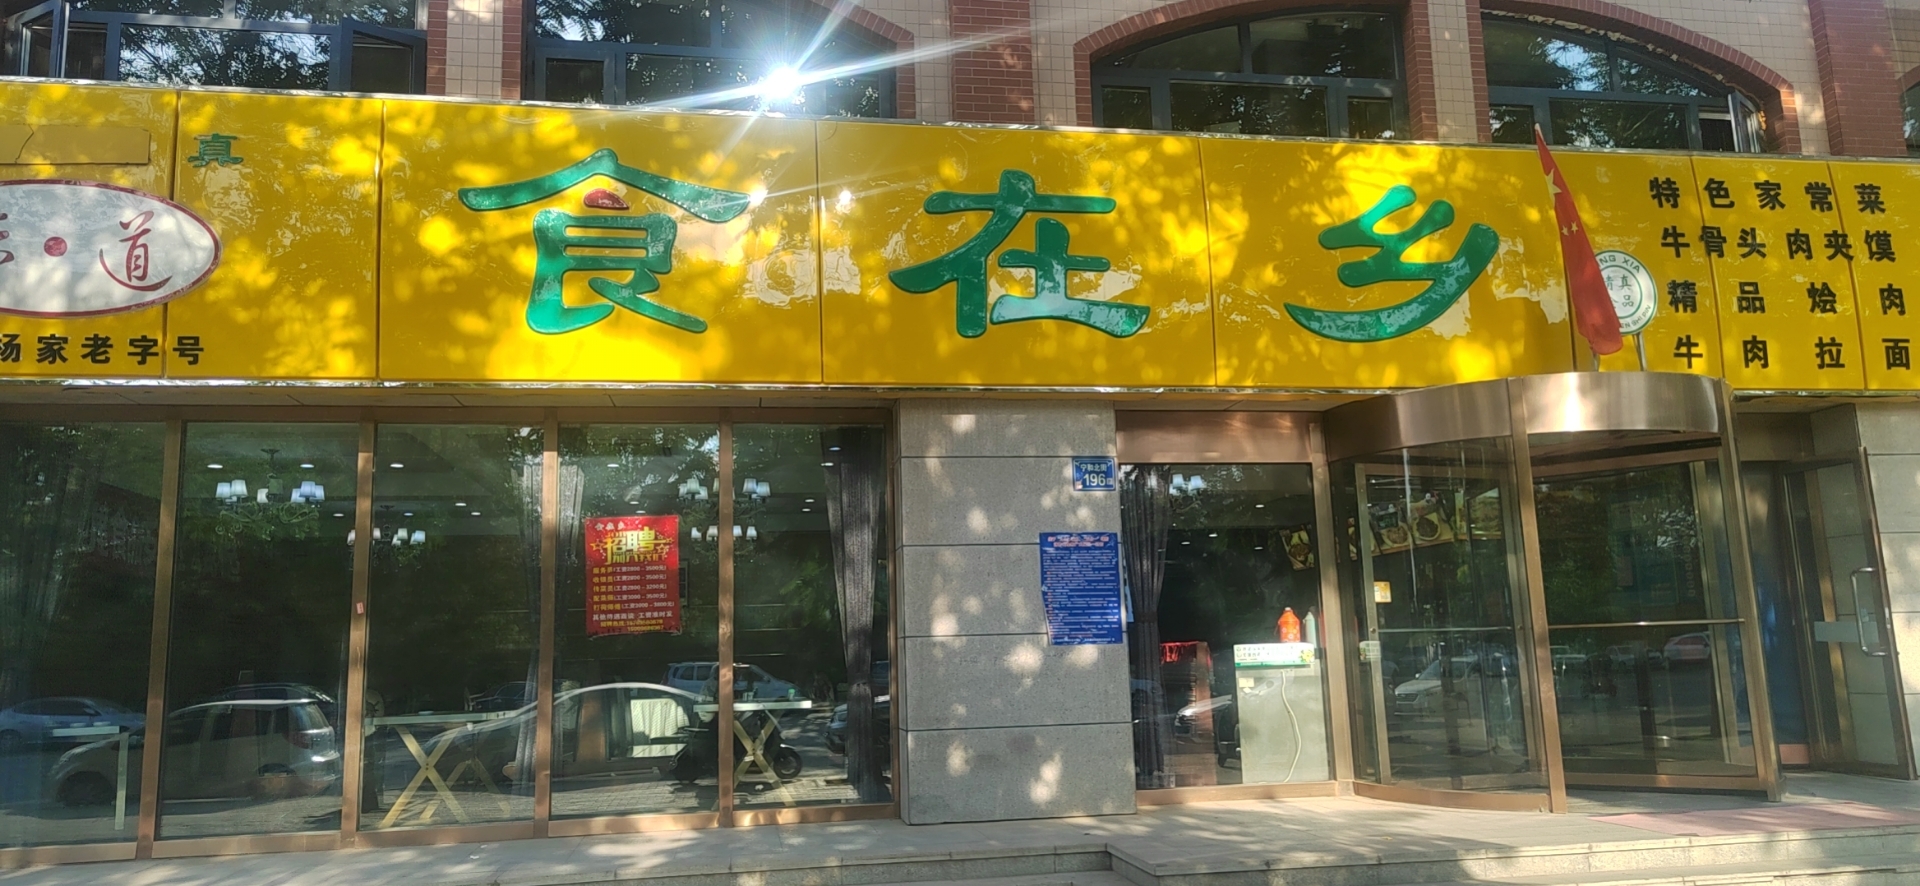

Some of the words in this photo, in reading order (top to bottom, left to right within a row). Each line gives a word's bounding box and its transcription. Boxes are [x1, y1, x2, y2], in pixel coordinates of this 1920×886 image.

[188, 132, 244, 168] 真
[1649, 176, 1887, 215] 特色家常菜
[458, 148, 1501, 343] 食在乡
[1597, 254, 1617, 266] NG
[1621, 256, 1641, 274] XIA
[1667, 280, 1906, 317] 精品烩肉
[1673, 335, 1912, 371] 牛肉拉面
[603, 526, 668, 565] 招聘
